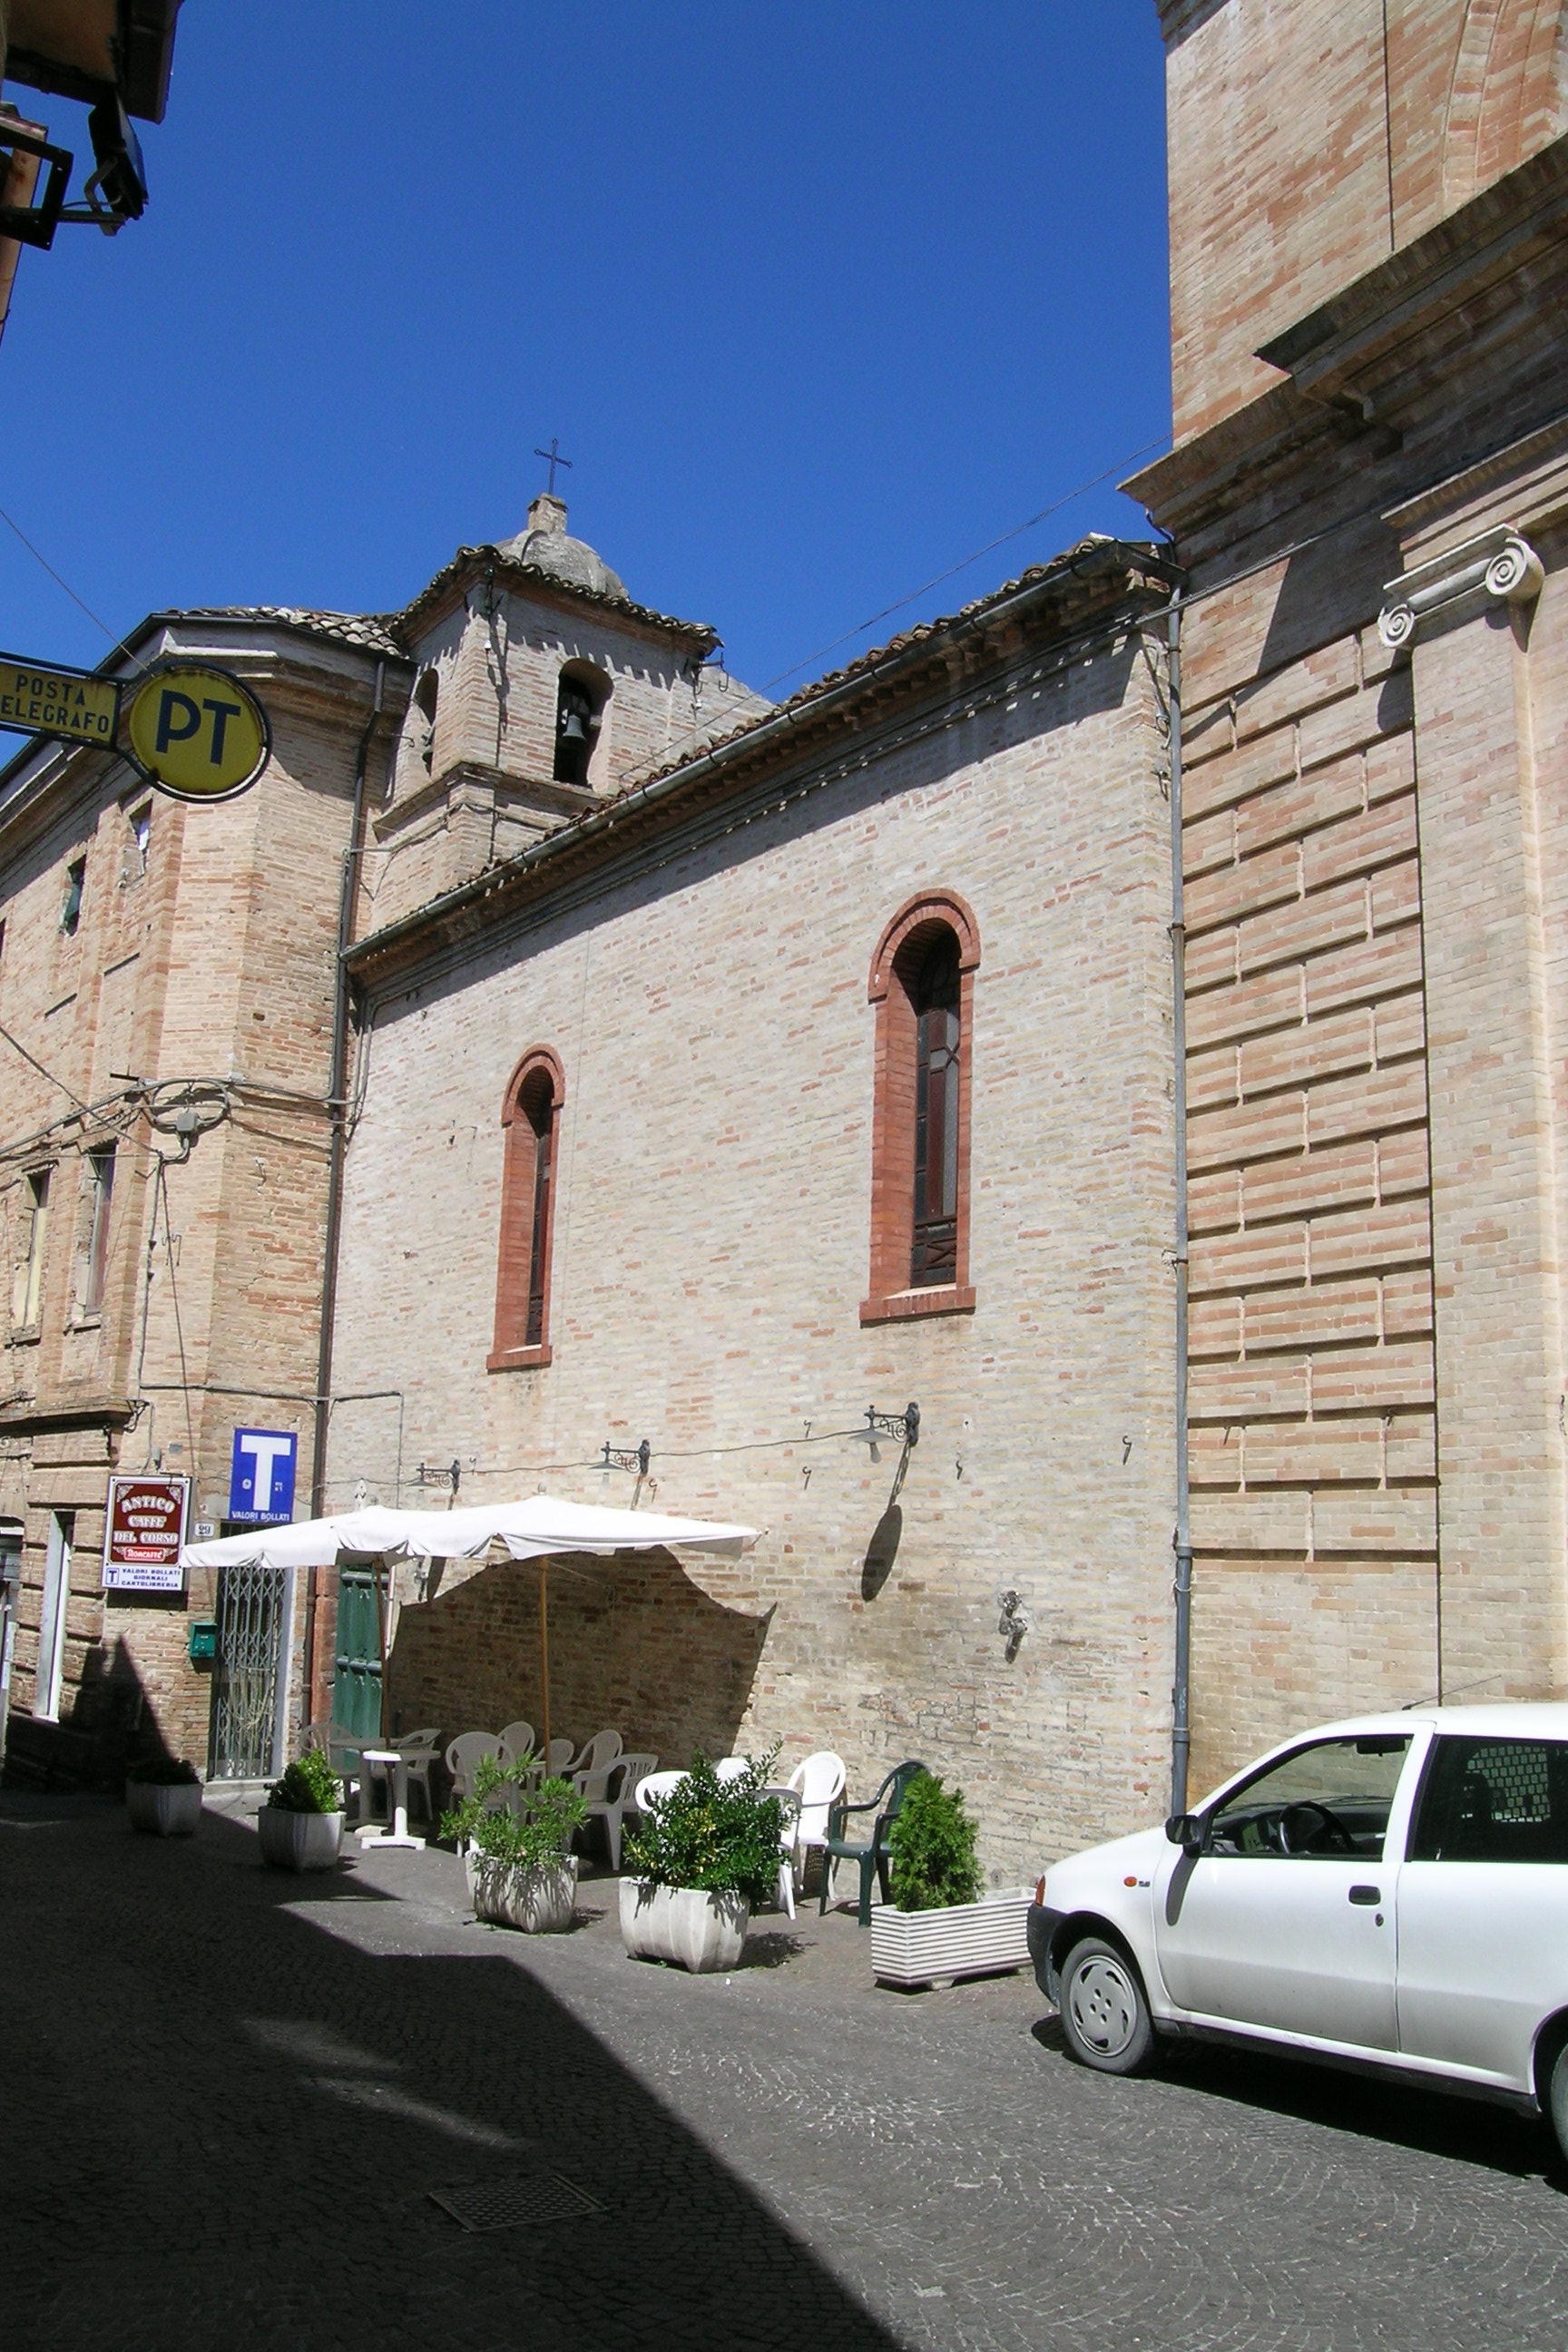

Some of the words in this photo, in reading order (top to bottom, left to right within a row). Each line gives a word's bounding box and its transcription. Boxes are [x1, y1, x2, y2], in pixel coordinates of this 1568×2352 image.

[15, 674, 86, 707] POSTA
[155, 689, 241, 768] PT
[240, 1435, 291, 1511] T
[122, 1495, 175, 1514] ANTICO
[231, 1511, 258, 1521] VALORI
[260, 1513, 289, 1522] BOLLATI
[113, 1531, 137, 1544] DEL
[140, 1532, 179, 1544] CORSO
[108, 1570, 117, 1583] T
